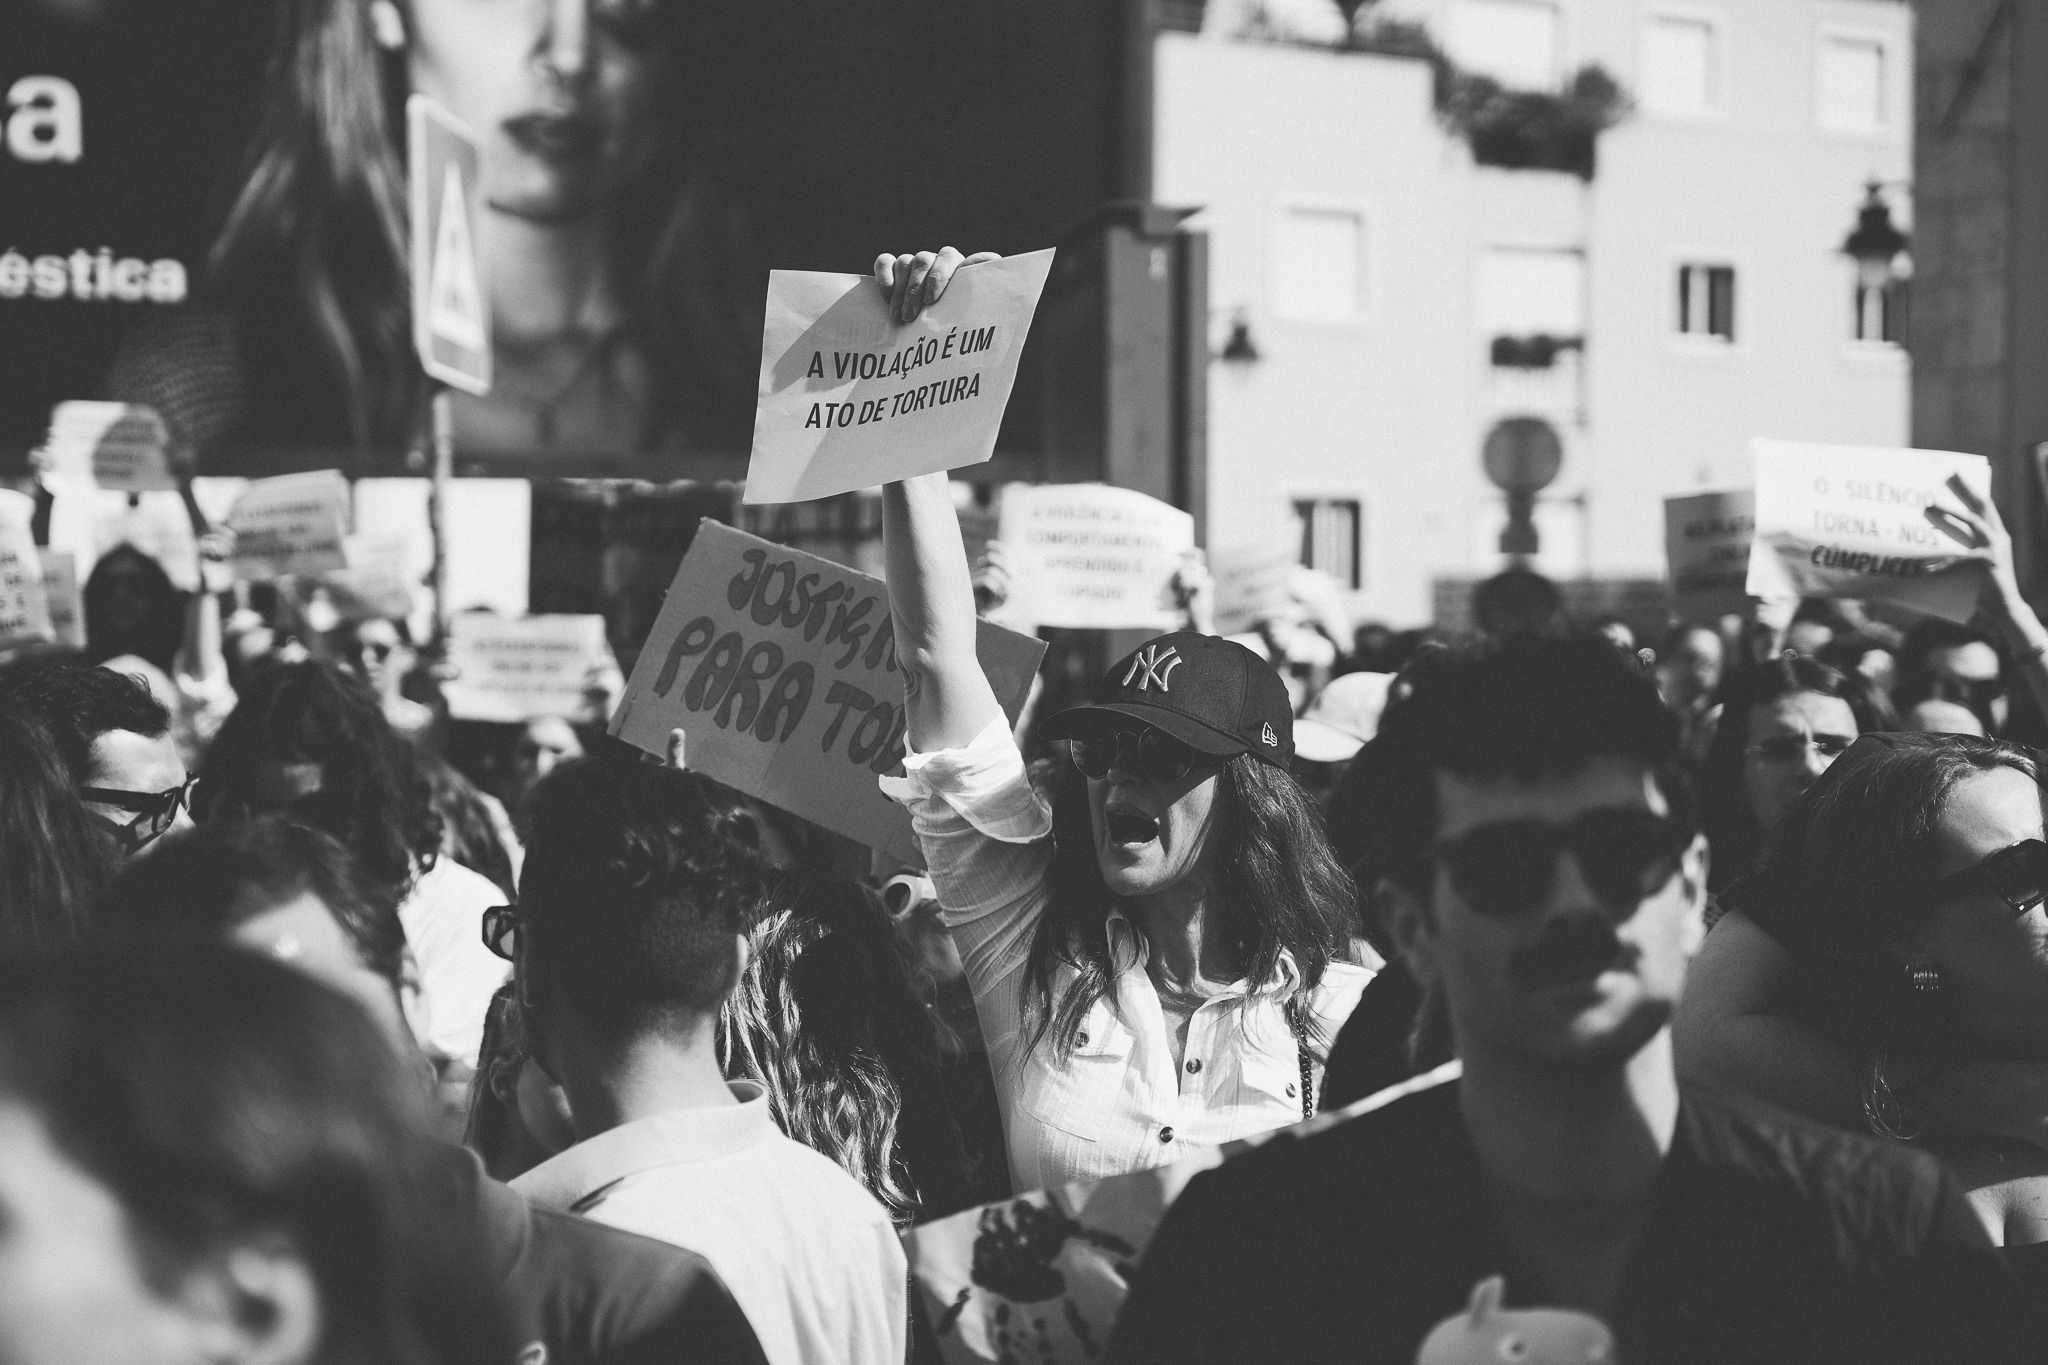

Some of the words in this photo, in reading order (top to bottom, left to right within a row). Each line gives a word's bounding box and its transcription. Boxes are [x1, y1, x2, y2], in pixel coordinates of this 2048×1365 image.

[0, 75, 82, 164] a
[806, 351, 824, 379] A
[834, 336, 939, 380] VIOLAÇÃO
[941, 326, 958, 360] É
[960, 325, 997, 356] UM
[804, 402, 855, 429] ATO
[857, 397, 888, 425] DE
[890, 372, 981, 418] TORTURA
[653, 615, 815, 743] PARA
[1121, 644, 1184, 692] NY
